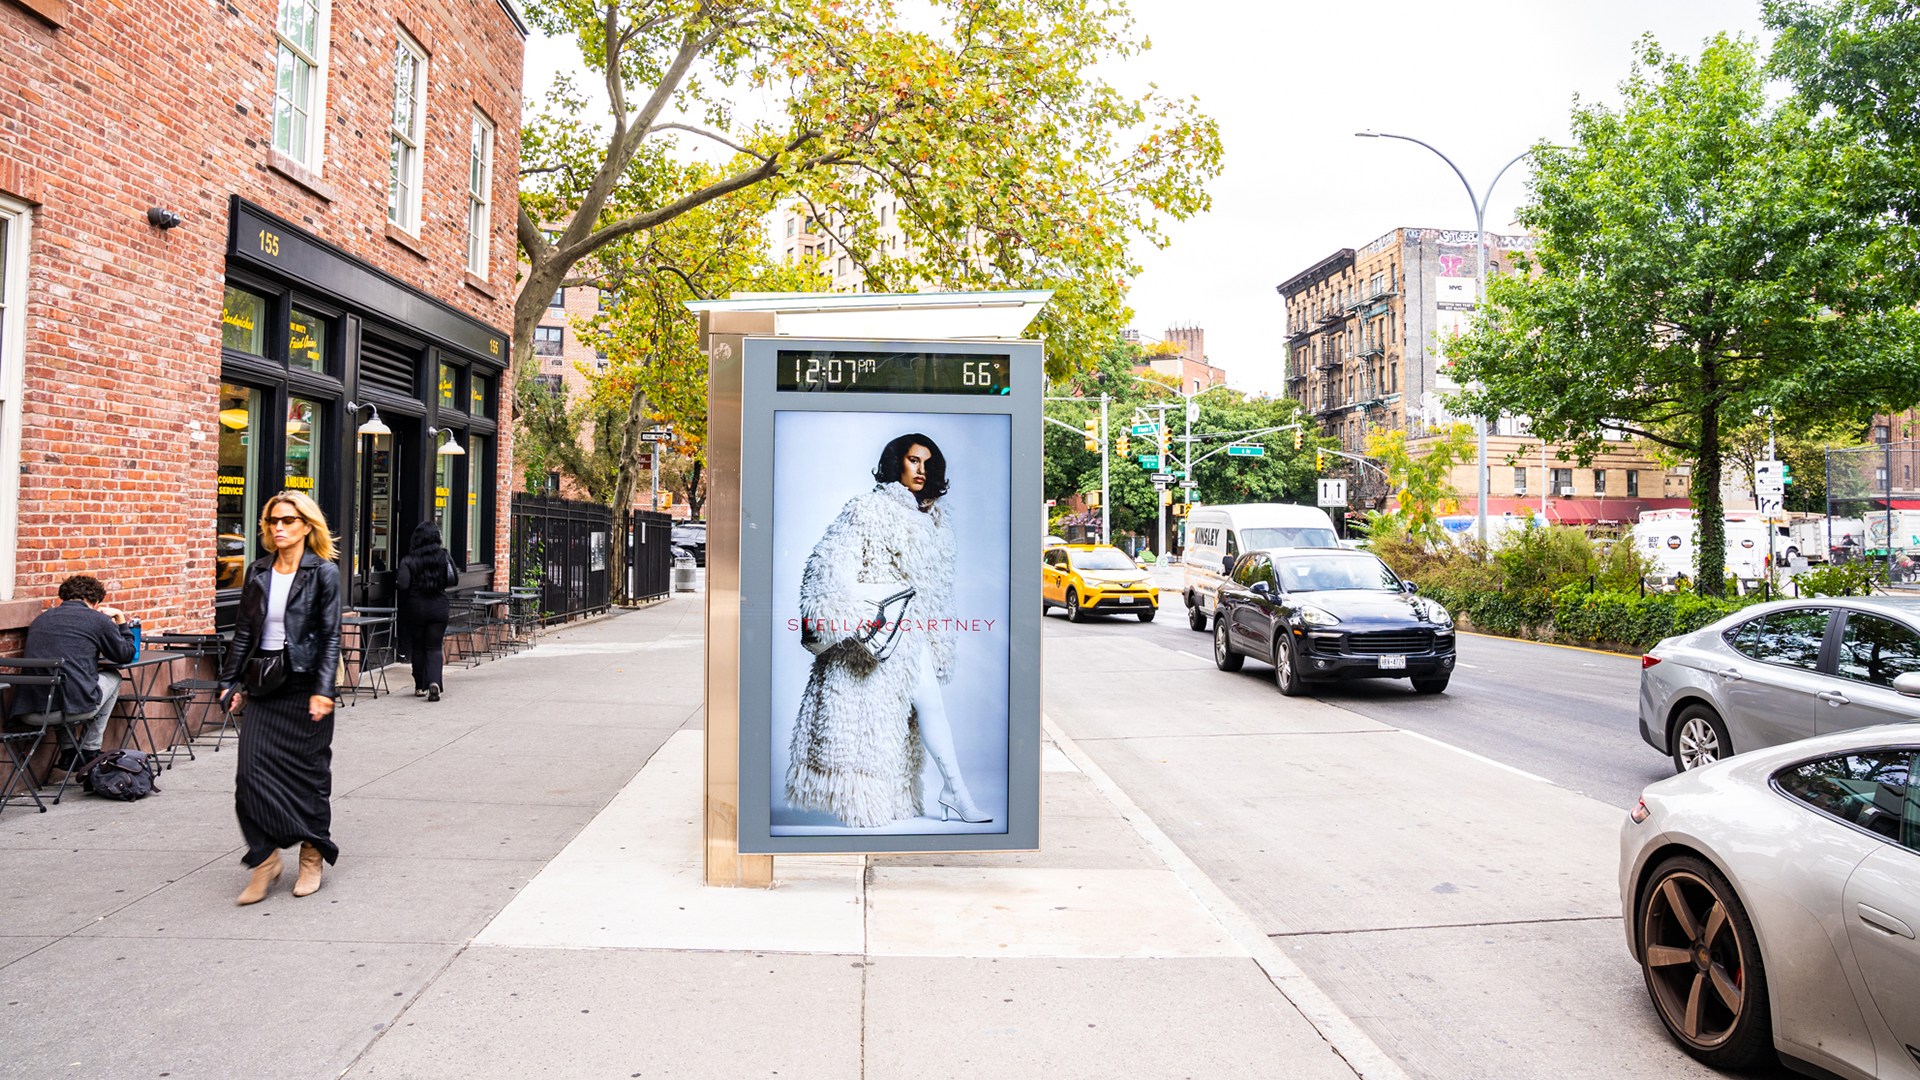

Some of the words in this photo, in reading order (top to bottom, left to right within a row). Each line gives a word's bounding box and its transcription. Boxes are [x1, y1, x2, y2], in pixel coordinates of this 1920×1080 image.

[259, 229, 280, 257] 155
[222, 308, 254, 330] Sandwiches
[289, 336, 304, 349] Fried
[489, 338, 499, 355] 155
[218, 476, 245, 485] COUNTER
[285, 476, 315, 489] AMBURGER
[218, 487, 244, 495] SERVICE
[1195, 527, 1220, 546] KINSLEY
